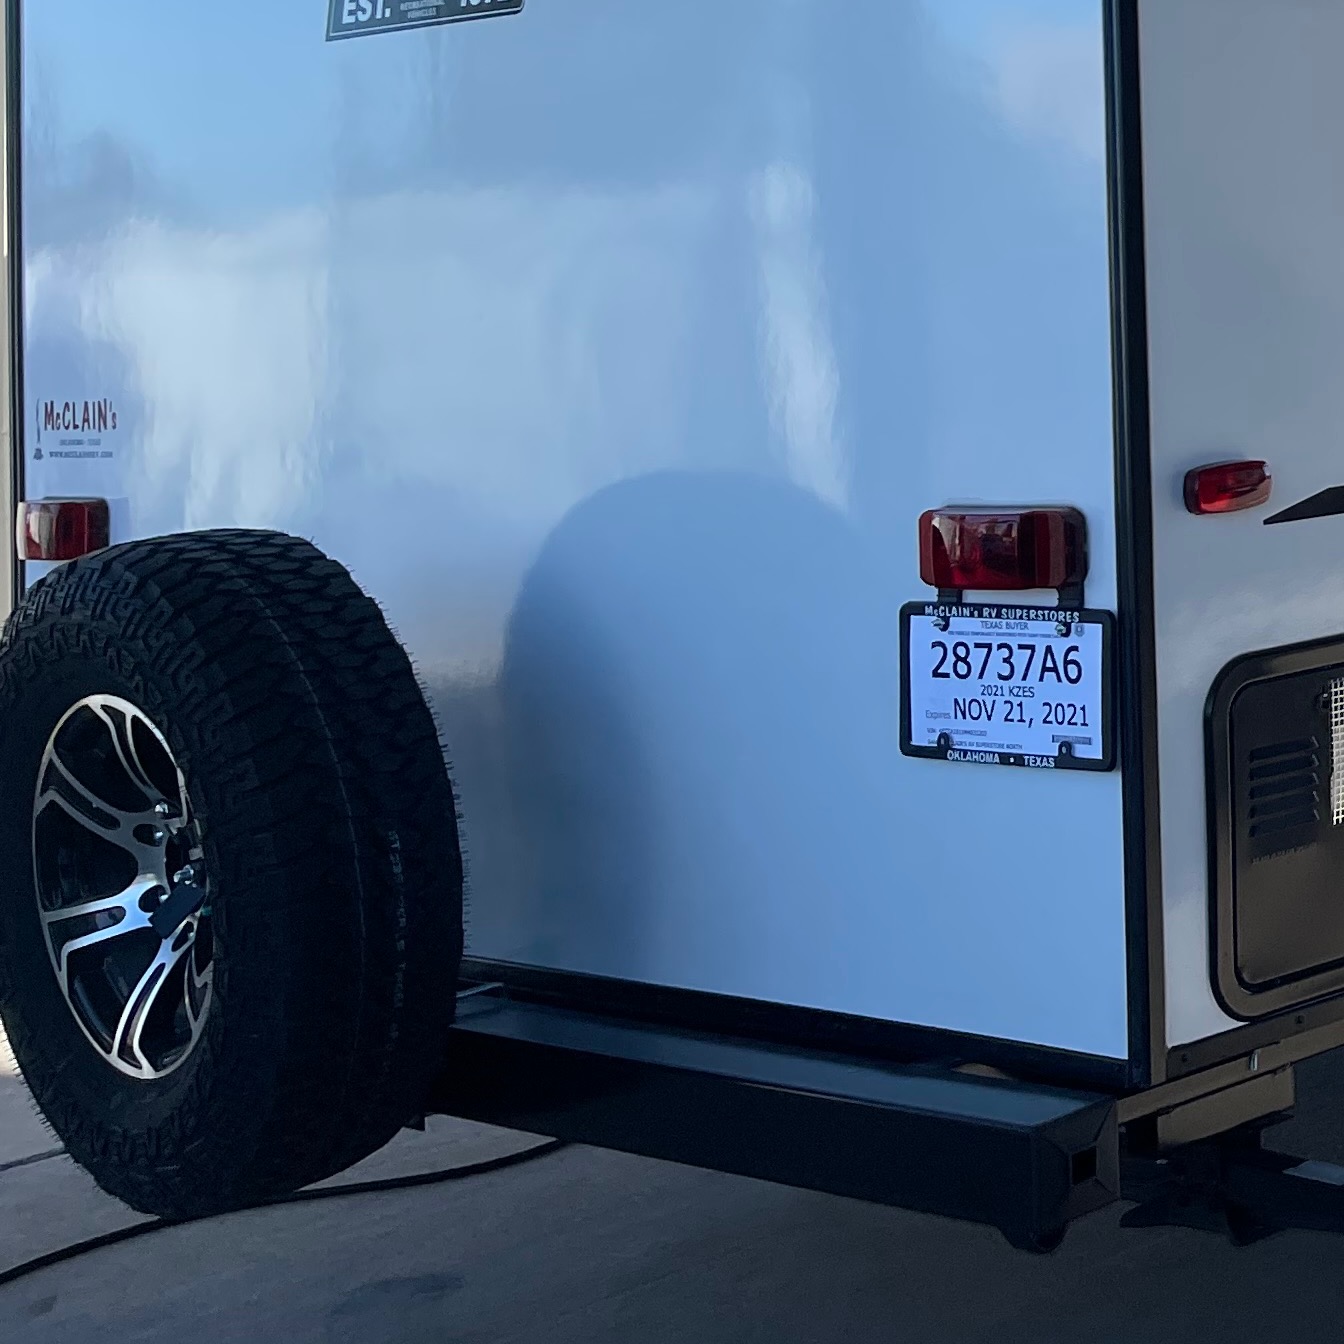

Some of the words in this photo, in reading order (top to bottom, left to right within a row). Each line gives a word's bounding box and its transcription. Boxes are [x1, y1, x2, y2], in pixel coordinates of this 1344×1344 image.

[44, 398, 117, 433] McCLAIN's
[924, 605, 979, 618] McCLAIN's
[982, 607, 998, 618] RV
[1001, 608, 1080, 623] SUPERSTORES
[980, 620, 1003, 630] TEXAS
[1005, 621, 1030, 631] BUYER
[930, 640, 1083, 685] 28737A6
[980, 684, 1005, 697] 2021
[1008, 686, 1035, 698] KZES
[953, 697, 996, 722] NOV
[1003, 700, 1033, 728] 21,
[1042, 702, 1089, 726] 2021
[946, 750, 1000, 764] OKLAHOMA
[1023, 755, 1055, 768] TEXAS
